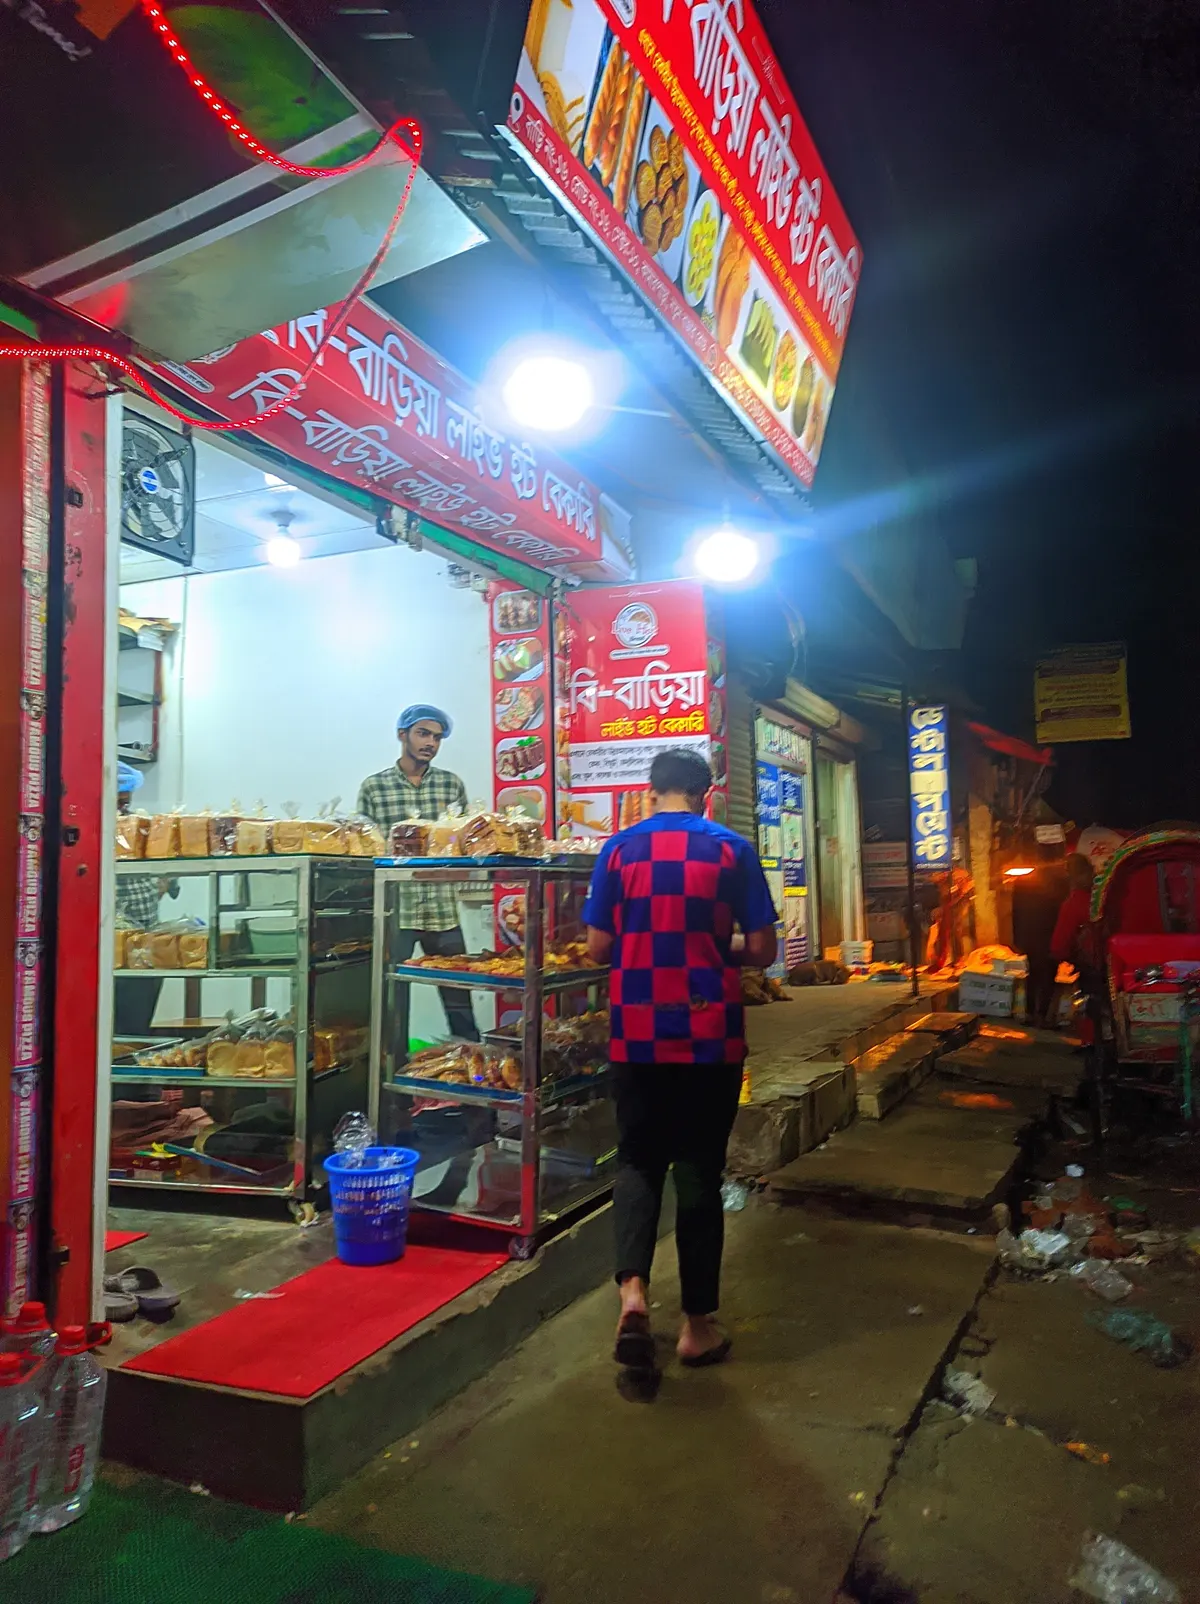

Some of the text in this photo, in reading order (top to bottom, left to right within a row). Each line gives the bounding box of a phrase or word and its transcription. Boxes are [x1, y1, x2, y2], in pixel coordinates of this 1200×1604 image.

[750, 99, 800, 229] লাইভ
[790, 176, 822, 265] হট
[807, 224, 862, 338] বেকারি
[393, 470, 478, 511] লাইভ
[460, 506, 517, 530] হট
[492, 530, 580, 561] বেকারি
[509, 442, 538, 500] হট
[541, 469, 596, 542] বেকারি
[568, 660, 707, 714] বি-বাড়িয়া
[600, 710, 705, 737] লাইভ হট বেকারি
[28, 721, 42, 808] FAMOUS PIZZA
[24, 843, 39, 932] FAMOUS PIZZA
[21, 970, 36, 1061] FAMOUS PIZZA
